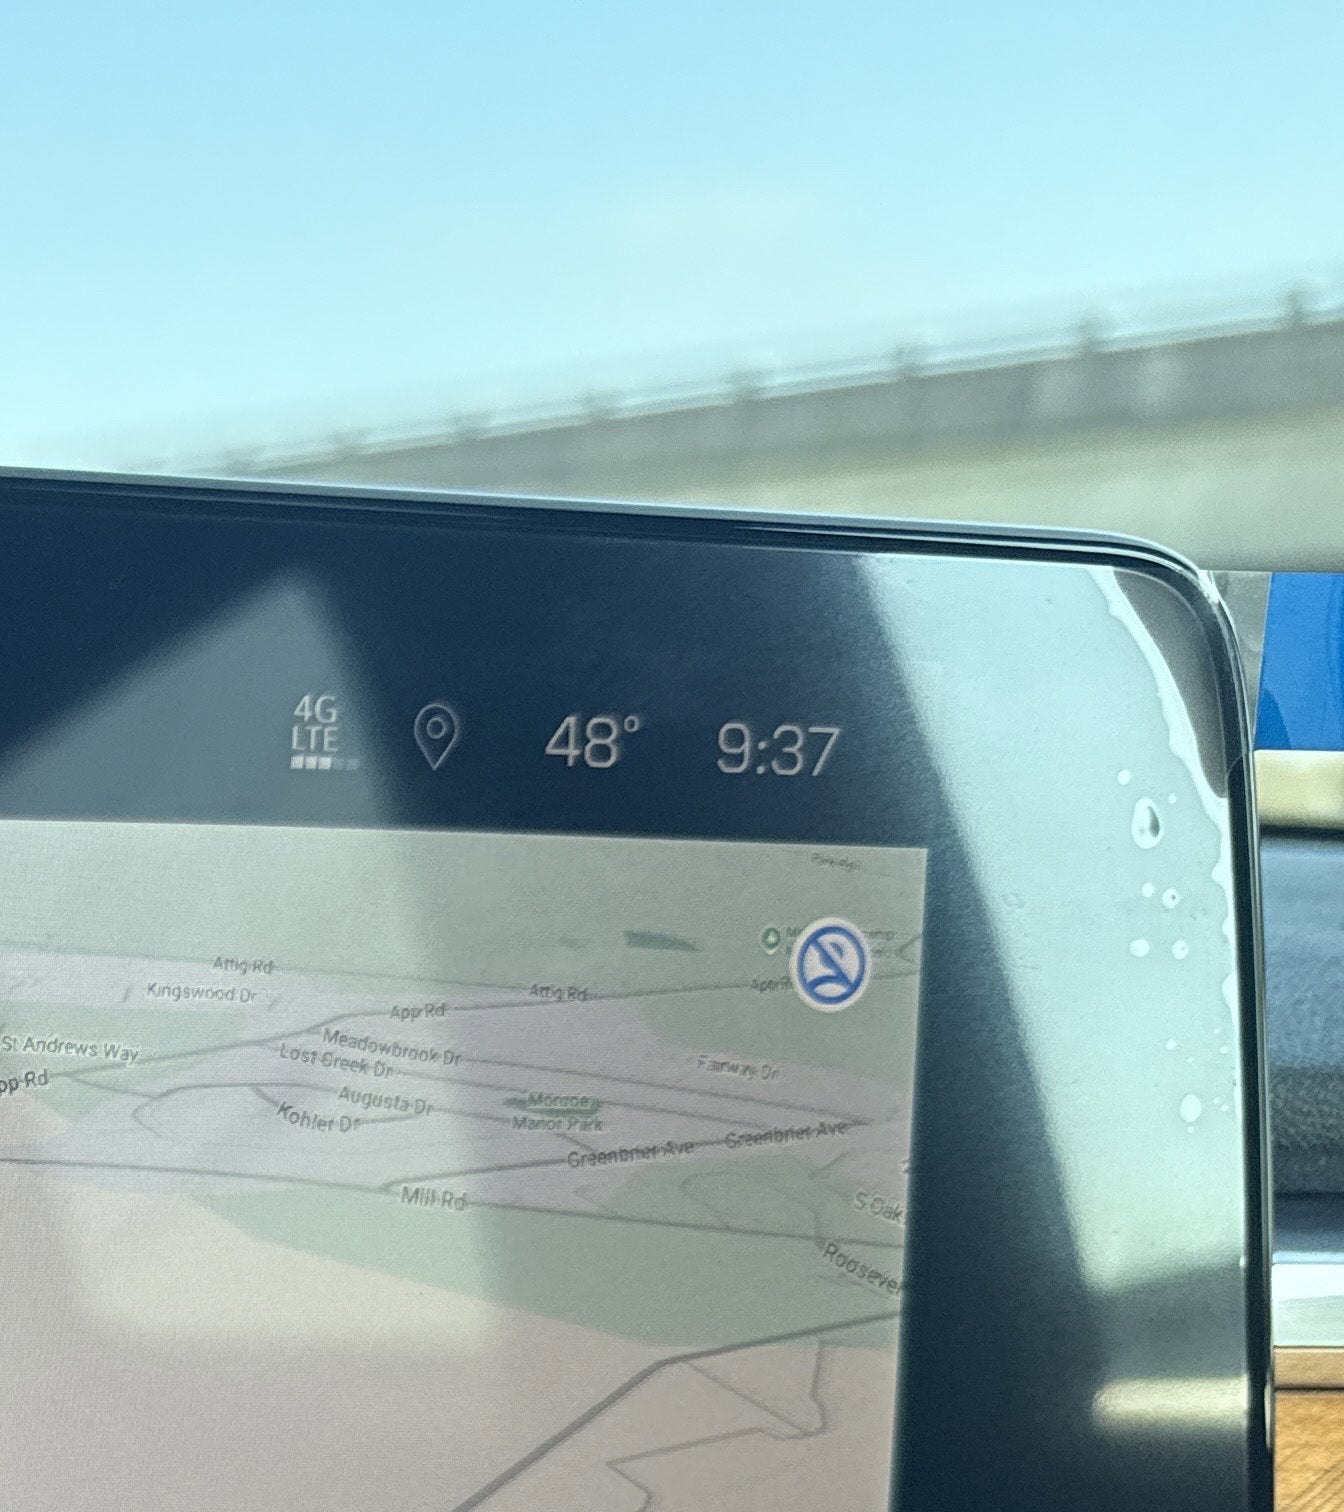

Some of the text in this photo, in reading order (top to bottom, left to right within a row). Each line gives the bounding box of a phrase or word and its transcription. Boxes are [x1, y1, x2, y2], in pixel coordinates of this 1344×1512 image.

[292, 696, 338, 724] 4G
[291, 725, 339, 753] LTE
[544, 714, 641, 769] 48°
[716, 722, 841, 777] 9:37
[252, 959, 274, 975] Rd
[145, 982, 258, 1003] Kingswood Dr
[424, 1003, 446, 1019] Rd
[1, 1035, 140, 1063] St Andrews Way
[442, 1049, 462, 1067] Dr
[24, 1068, 49, 1089] Rd
[373, 1060, 393, 1078] Dr
[338, 1085, 433, 1116] Augusta Dr
[277, 1101, 362, 1134] Kohler Dr
[440, 1189, 467, 1211] Rd
